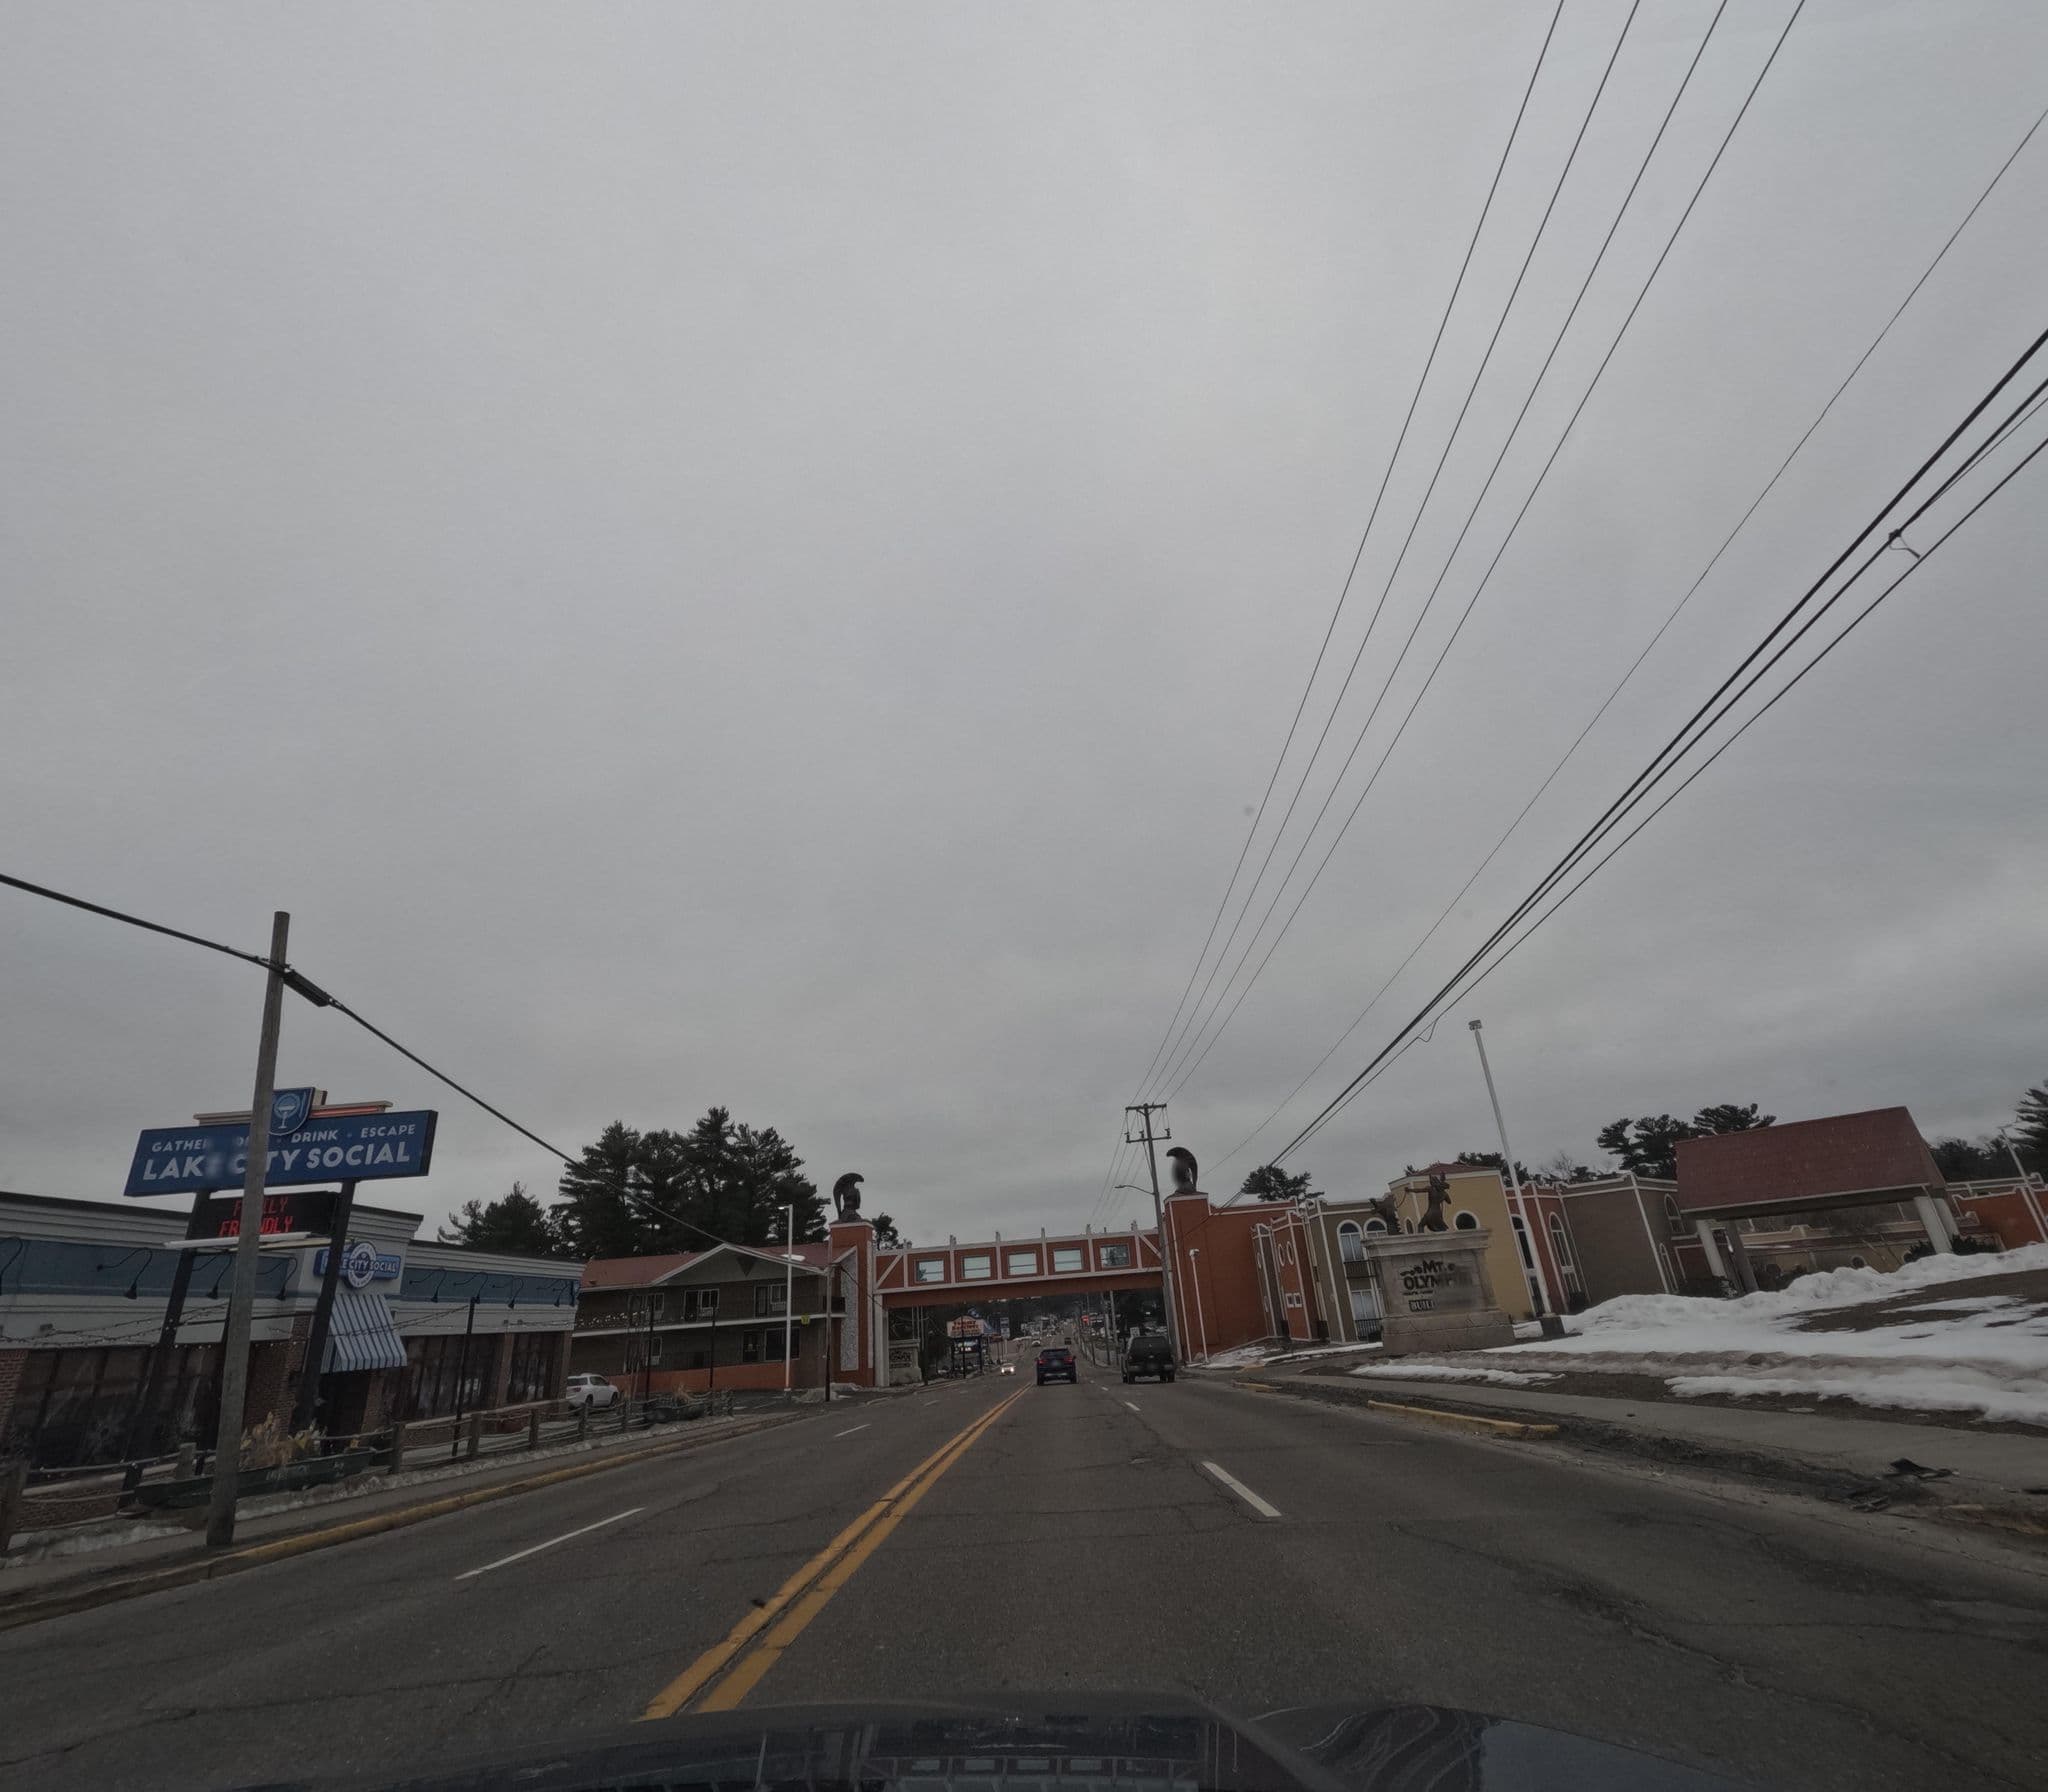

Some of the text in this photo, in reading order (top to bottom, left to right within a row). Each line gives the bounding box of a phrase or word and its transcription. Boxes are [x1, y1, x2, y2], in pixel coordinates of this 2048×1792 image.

[291, 1129, 339, 1143] DRINK
[360, 1124, 416, 1138] ESCAPE
[229, 1149, 301, 1176] CTY
[306, 1141, 410, 1169] SOCIAL
[232, 1196, 288, 1217] FILY
[218, 1216, 293, 1237] FRNDLY
[348, 1258, 368, 1270] CITY
[369, 1260, 396, 1272] SOCIAL
